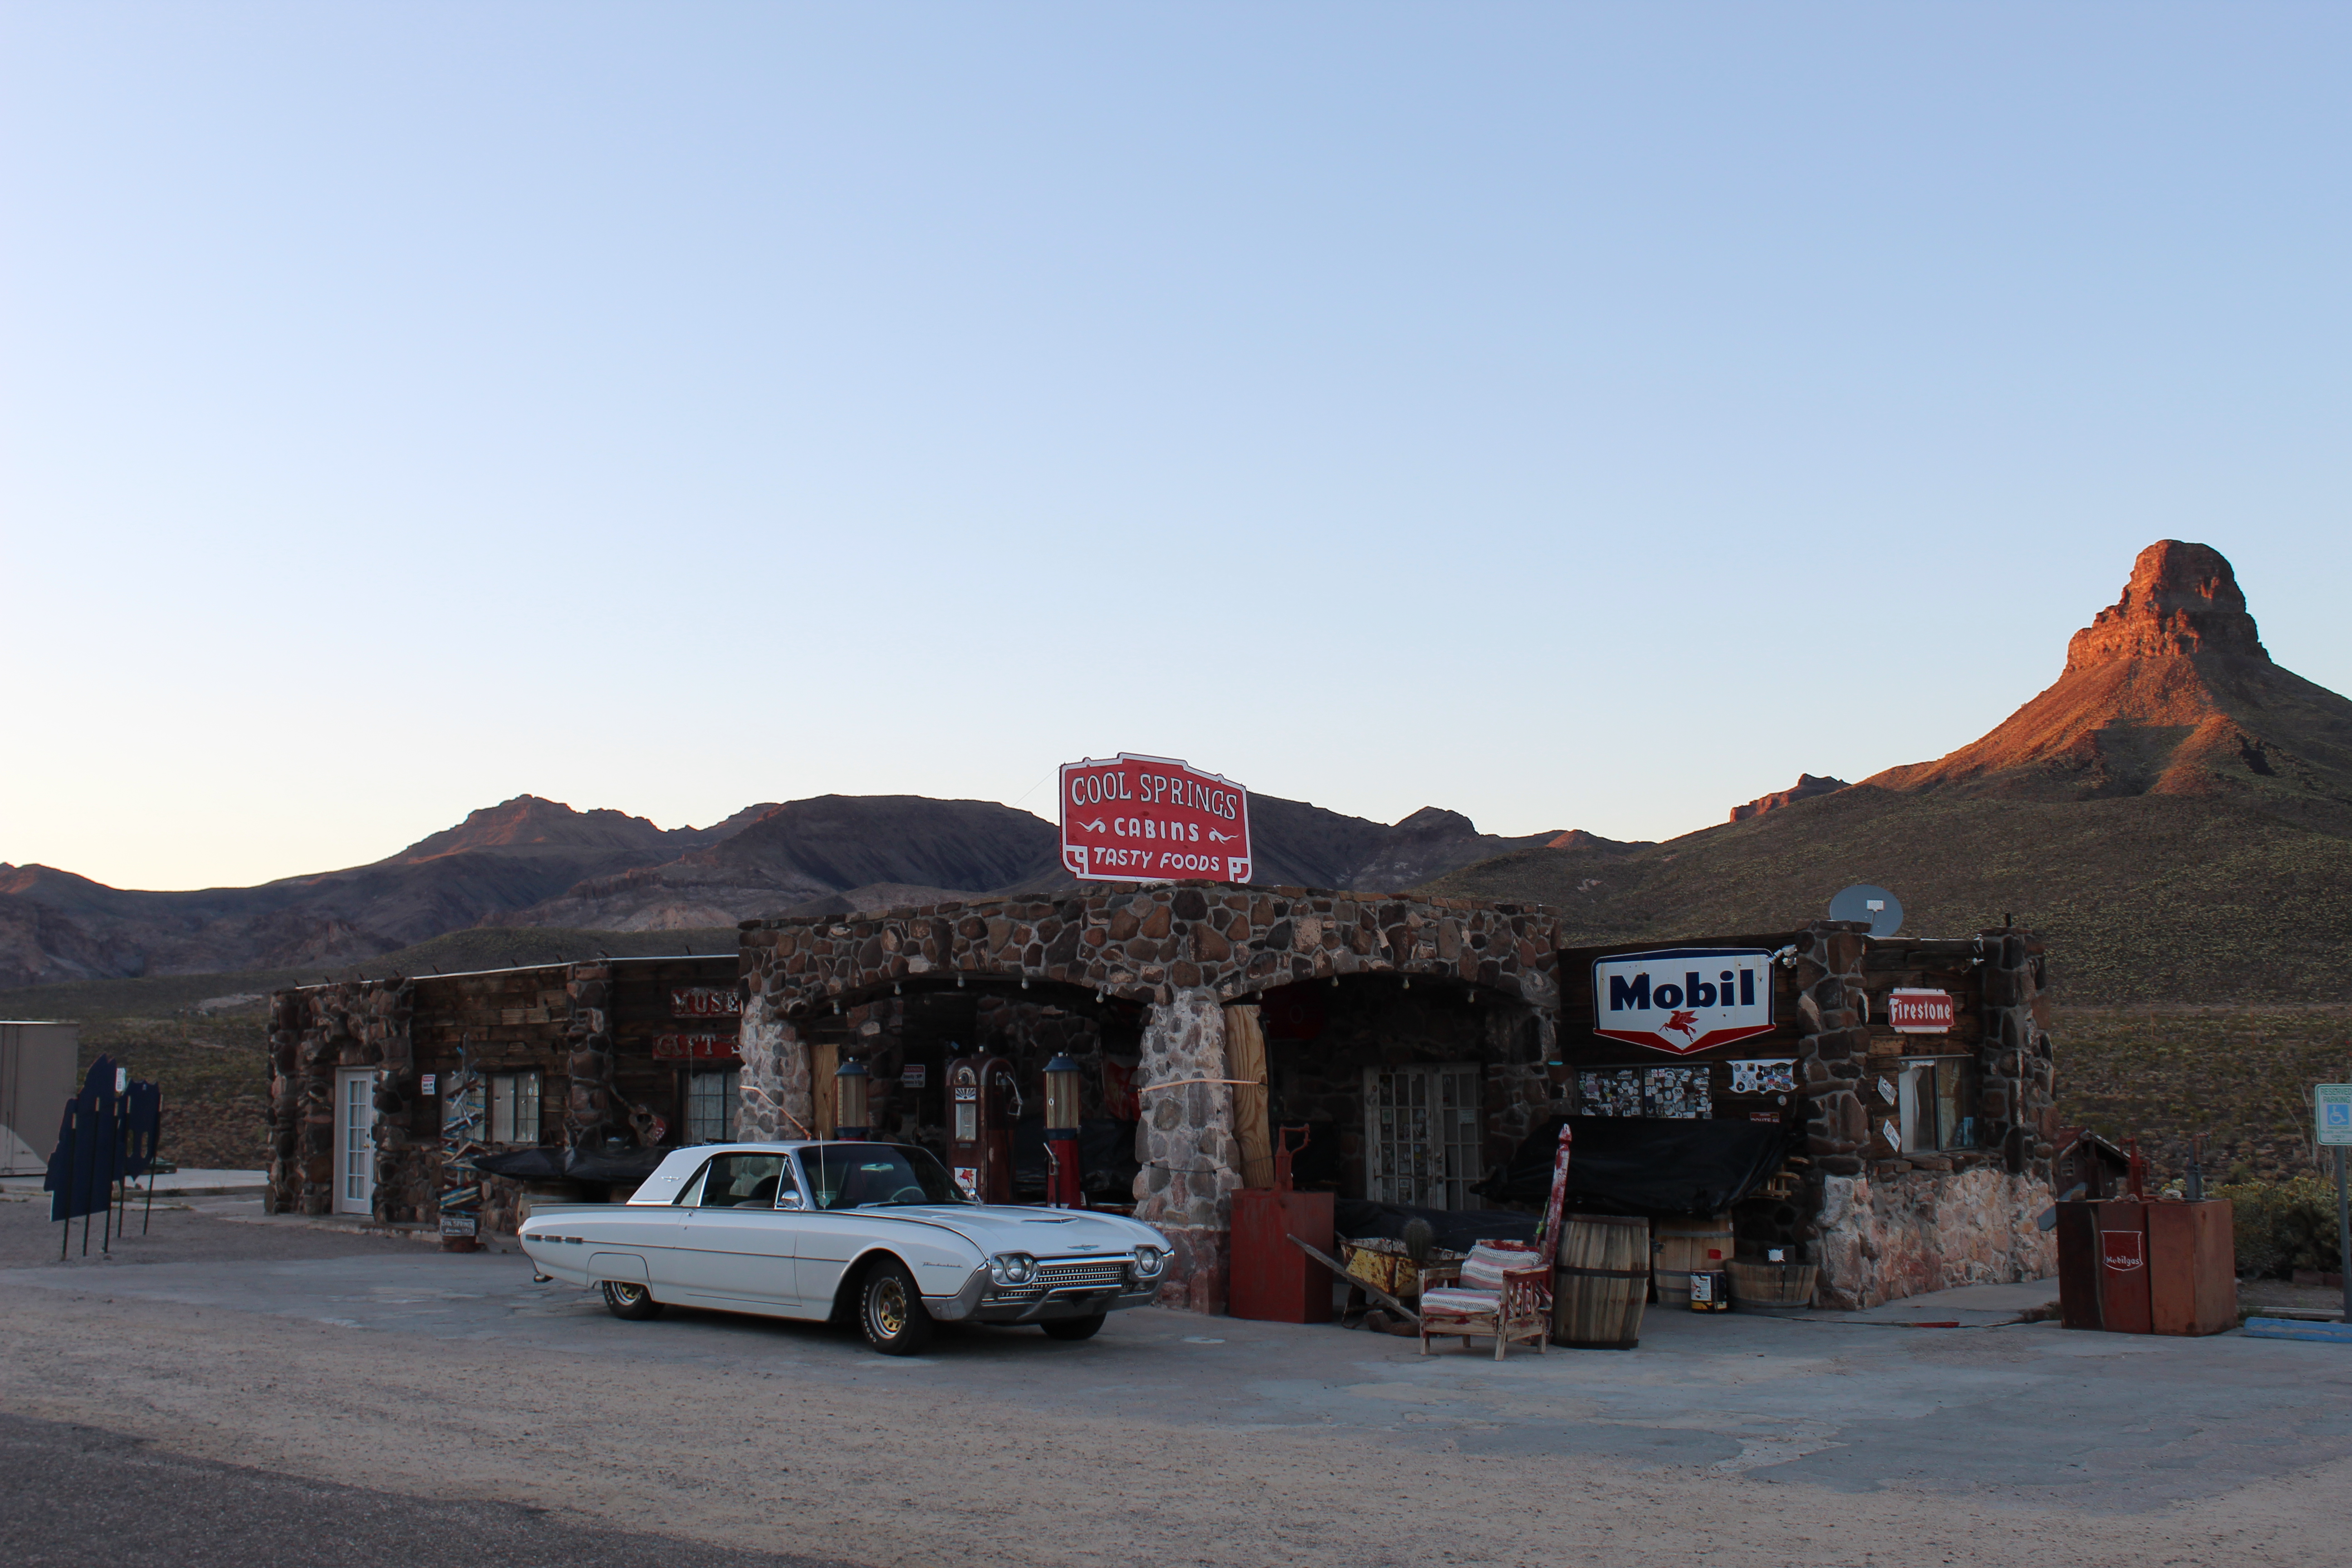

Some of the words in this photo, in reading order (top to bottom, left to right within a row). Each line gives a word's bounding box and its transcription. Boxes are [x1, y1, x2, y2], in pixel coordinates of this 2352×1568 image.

[1071, 772, 1132, 806] COOL
[1140, 774, 1237, 820] SPRINGS
[1114, 817, 1199, 842] CABINS
[1093, 847, 1153, 869] TASTY
[1160, 853, 1220, 872] FOODS
[672, 991, 740, 1013] MUSE
[1610, 969, 1755, 1011] Mobil
[1889, 998, 1950, 1023] Firestone
[2106, 1255, 2139, 1266] Mobilgas
[862, 1285, 877, 1343] GOODYEAR
